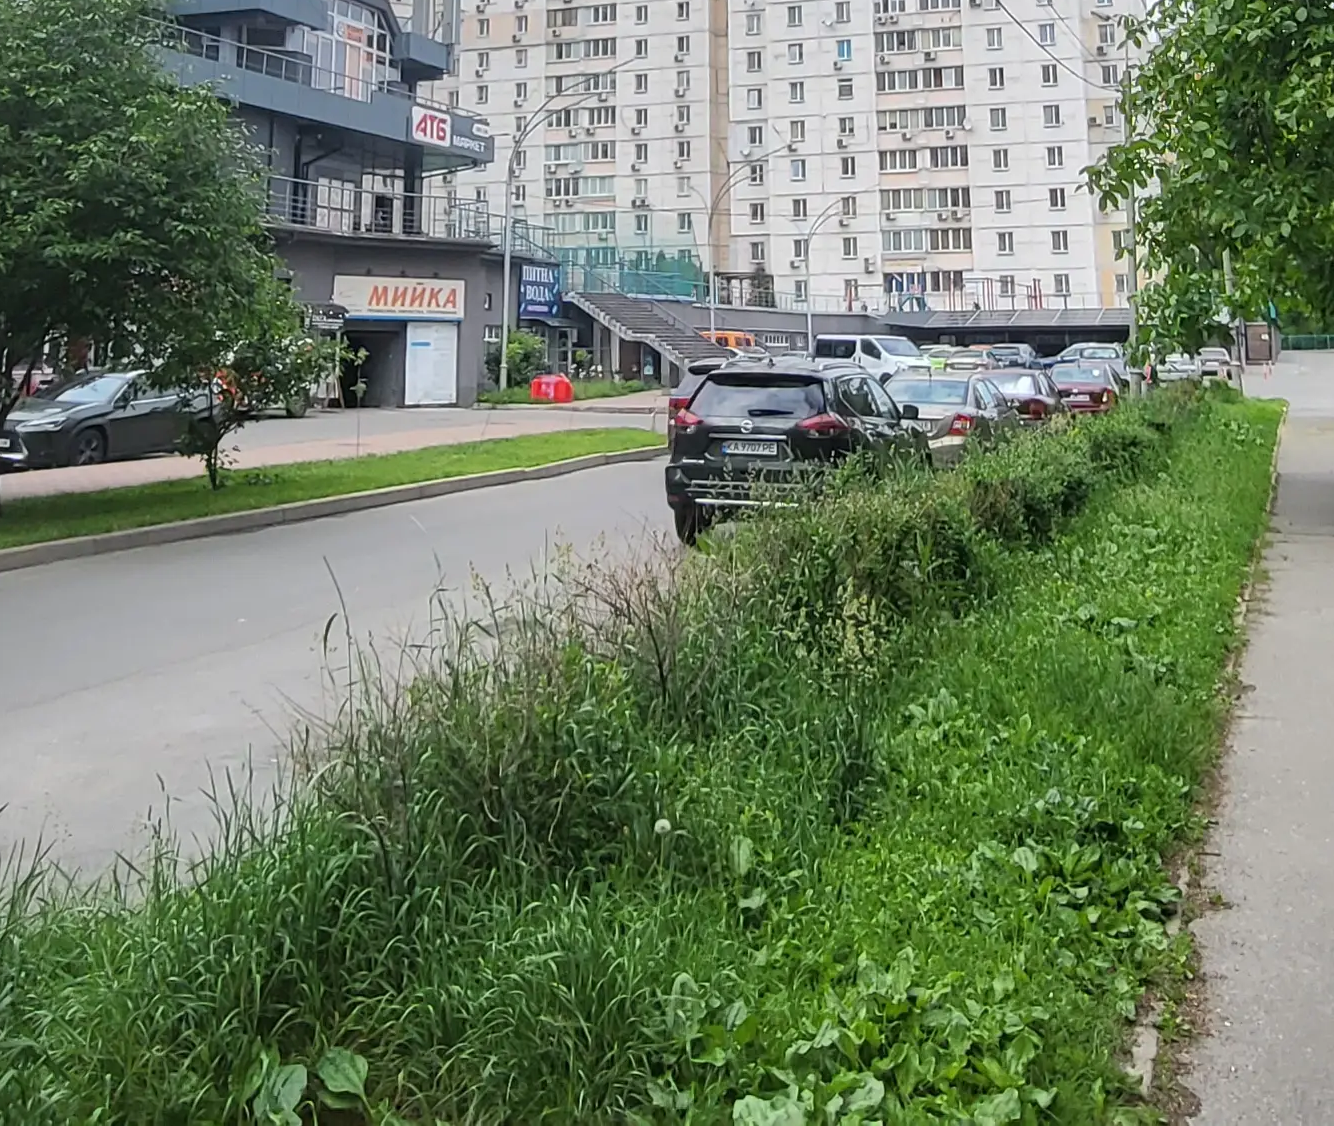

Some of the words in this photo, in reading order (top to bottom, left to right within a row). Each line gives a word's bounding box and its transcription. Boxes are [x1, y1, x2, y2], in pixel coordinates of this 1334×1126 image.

[415, 113, 448, 141] АТБ
[452, 135, 486, 153] МАРКЕТ
[526, 285, 554, 302] ВОДА
